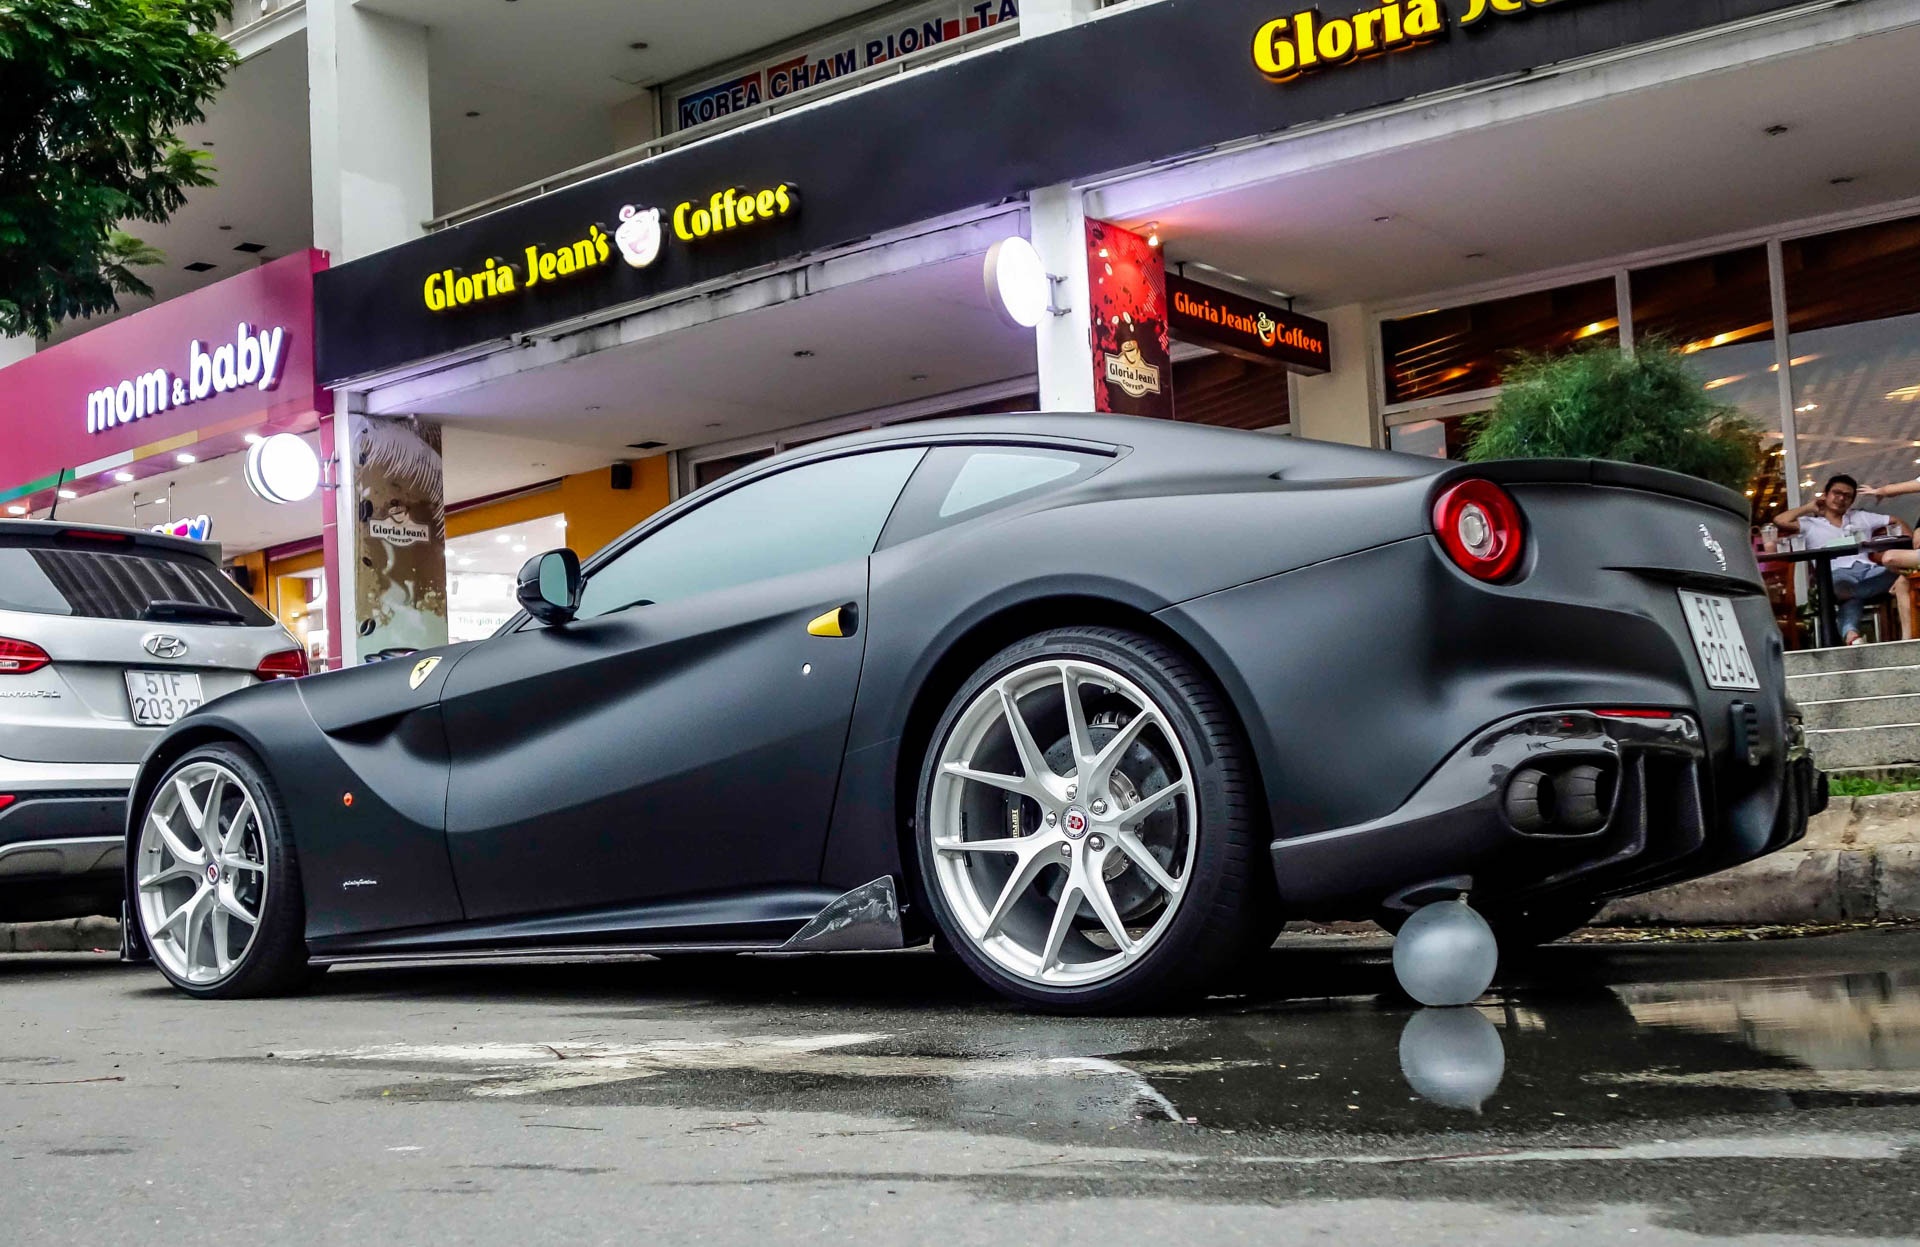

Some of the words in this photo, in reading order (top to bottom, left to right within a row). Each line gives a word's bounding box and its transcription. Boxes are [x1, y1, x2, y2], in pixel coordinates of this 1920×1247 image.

[1253, 0, 1440, 73] Gloria
[681, 81, 761, 130] KOREA
[424, 257, 515, 312] Gloria
[525, 225, 609, 288] Jean's
[673, 184, 790, 241] Coffees
[1174, 291, 1218, 323] Gloria
[1221, 305, 1258, 335] Jean's
[1276, 323, 1322, 353] Coffees
[87, 368, 169, 434] mom
[172, 377, 189, 406] &
[190, 321, 284, 401] baby
[1109, 362, 1134, 380] Gloria
[1134, 369, 1156, 385] Jean's
[372, 524, 401, 536] Gloria
[402, 527, 426, 538] Jean's
[1695, 597, 1727, 640] 51F
[144, 673, 181, 696] 51F
